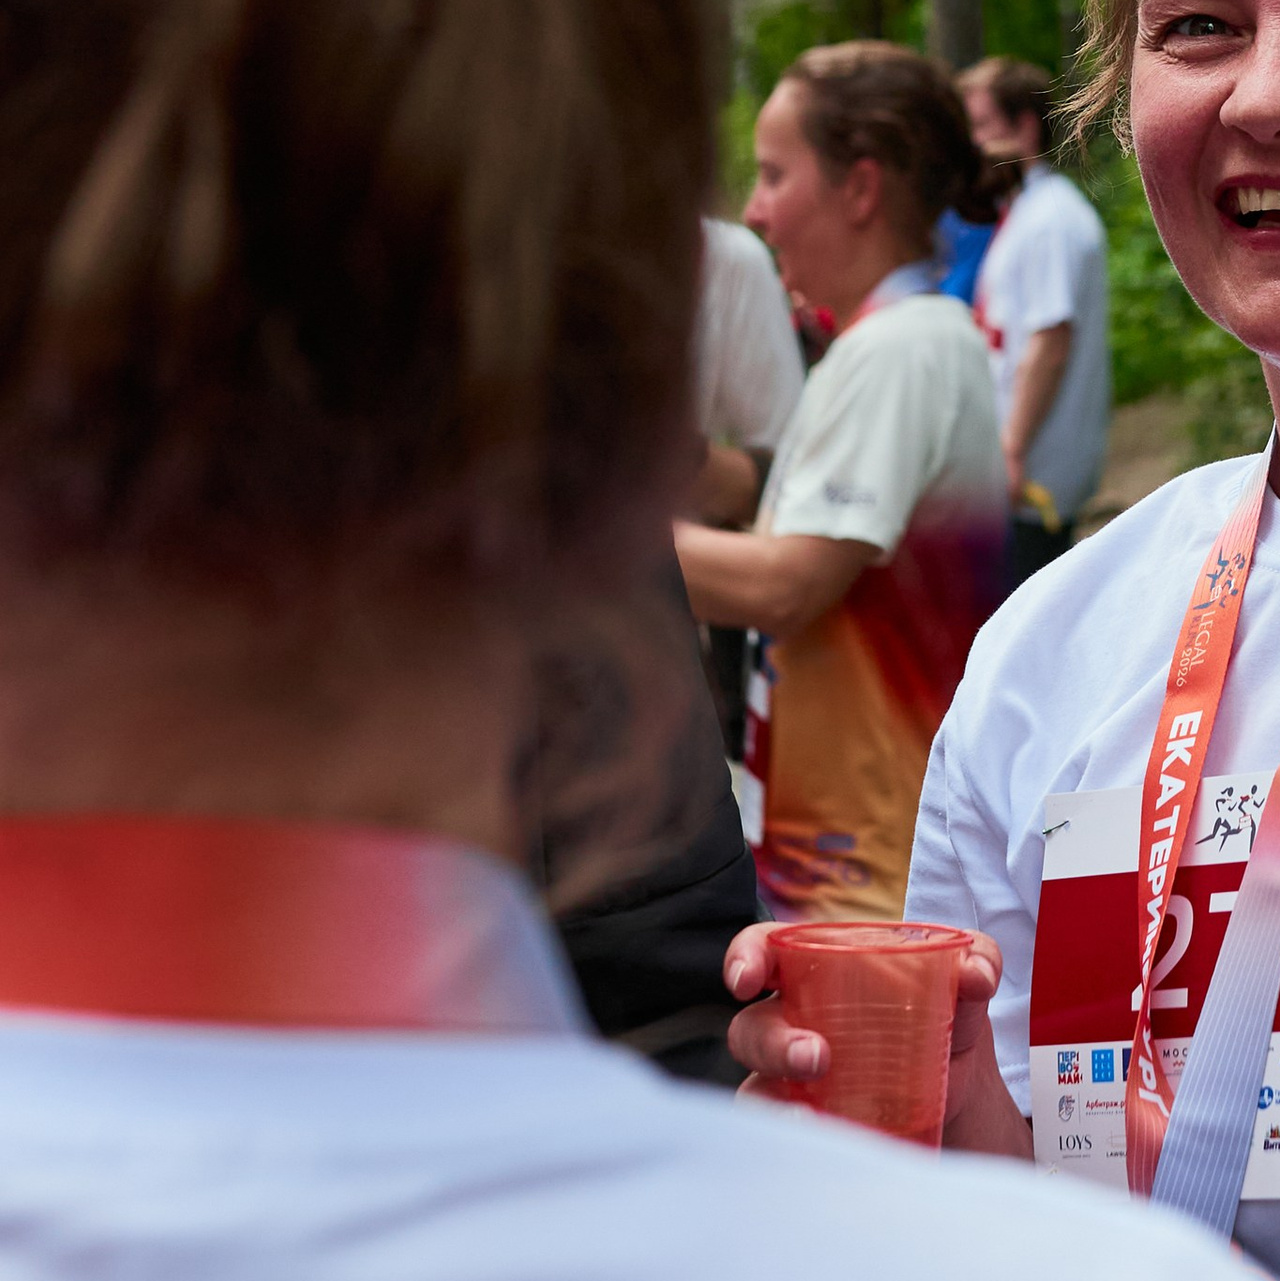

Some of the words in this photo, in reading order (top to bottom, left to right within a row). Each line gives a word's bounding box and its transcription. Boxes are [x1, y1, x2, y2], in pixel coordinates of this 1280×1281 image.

[1189, 610, 1216, 671] LEGAL
[1176, 647, 1193, 688] 2026
[1085, 1098, 1126, 1111] Арбитраж.р
[1059, 1134, 1092, 1150] LOYS
